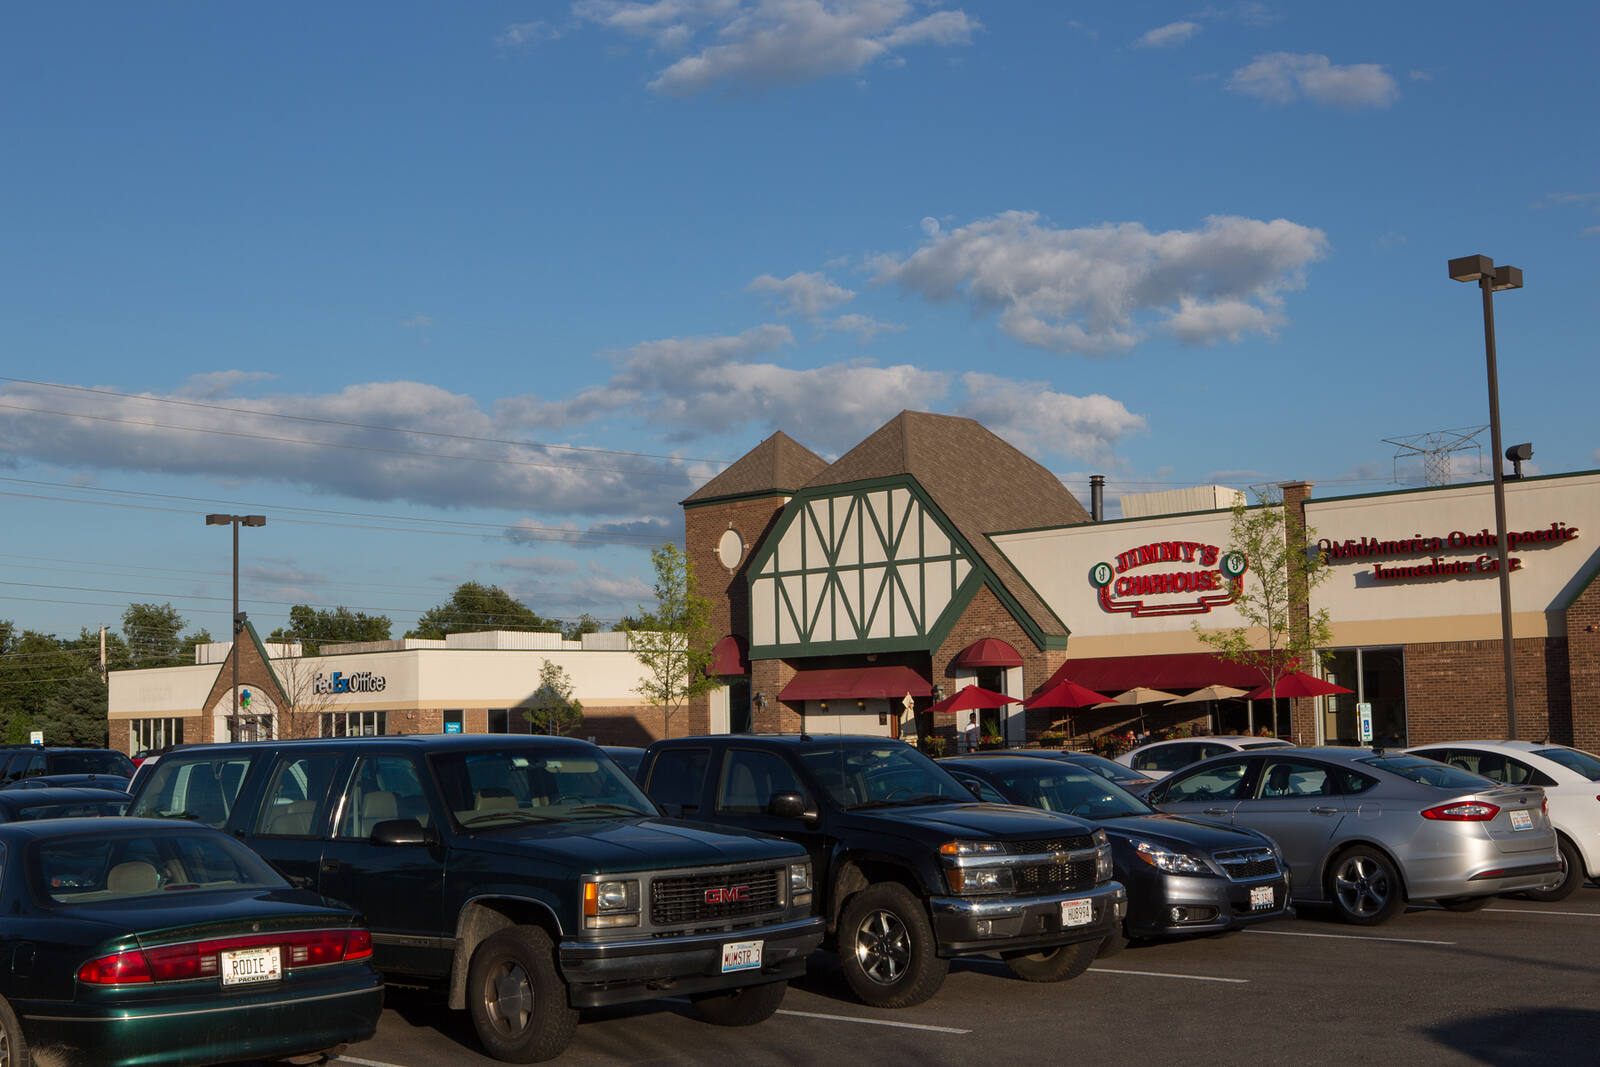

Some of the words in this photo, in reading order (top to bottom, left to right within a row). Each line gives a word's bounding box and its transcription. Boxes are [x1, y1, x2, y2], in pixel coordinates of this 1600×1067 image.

[1332, 534, 1442, 559] MidAmerica
[1447, 522, 1579, 552] Orthpaedic
[1115, 541, 1220, 573] JIMMY'S
[1374, 558, 1472, 581] Immediate
[1475, 555, 1522, 574] Cae
[1116, 569, 1223, 596] CHARHOUSE
[705, 886, 750, 903] GMC
[232, 957, 266, 976] RODIE
[756, 948, 761, 963] 3
[238, 975, 270, 983] PACKERS
